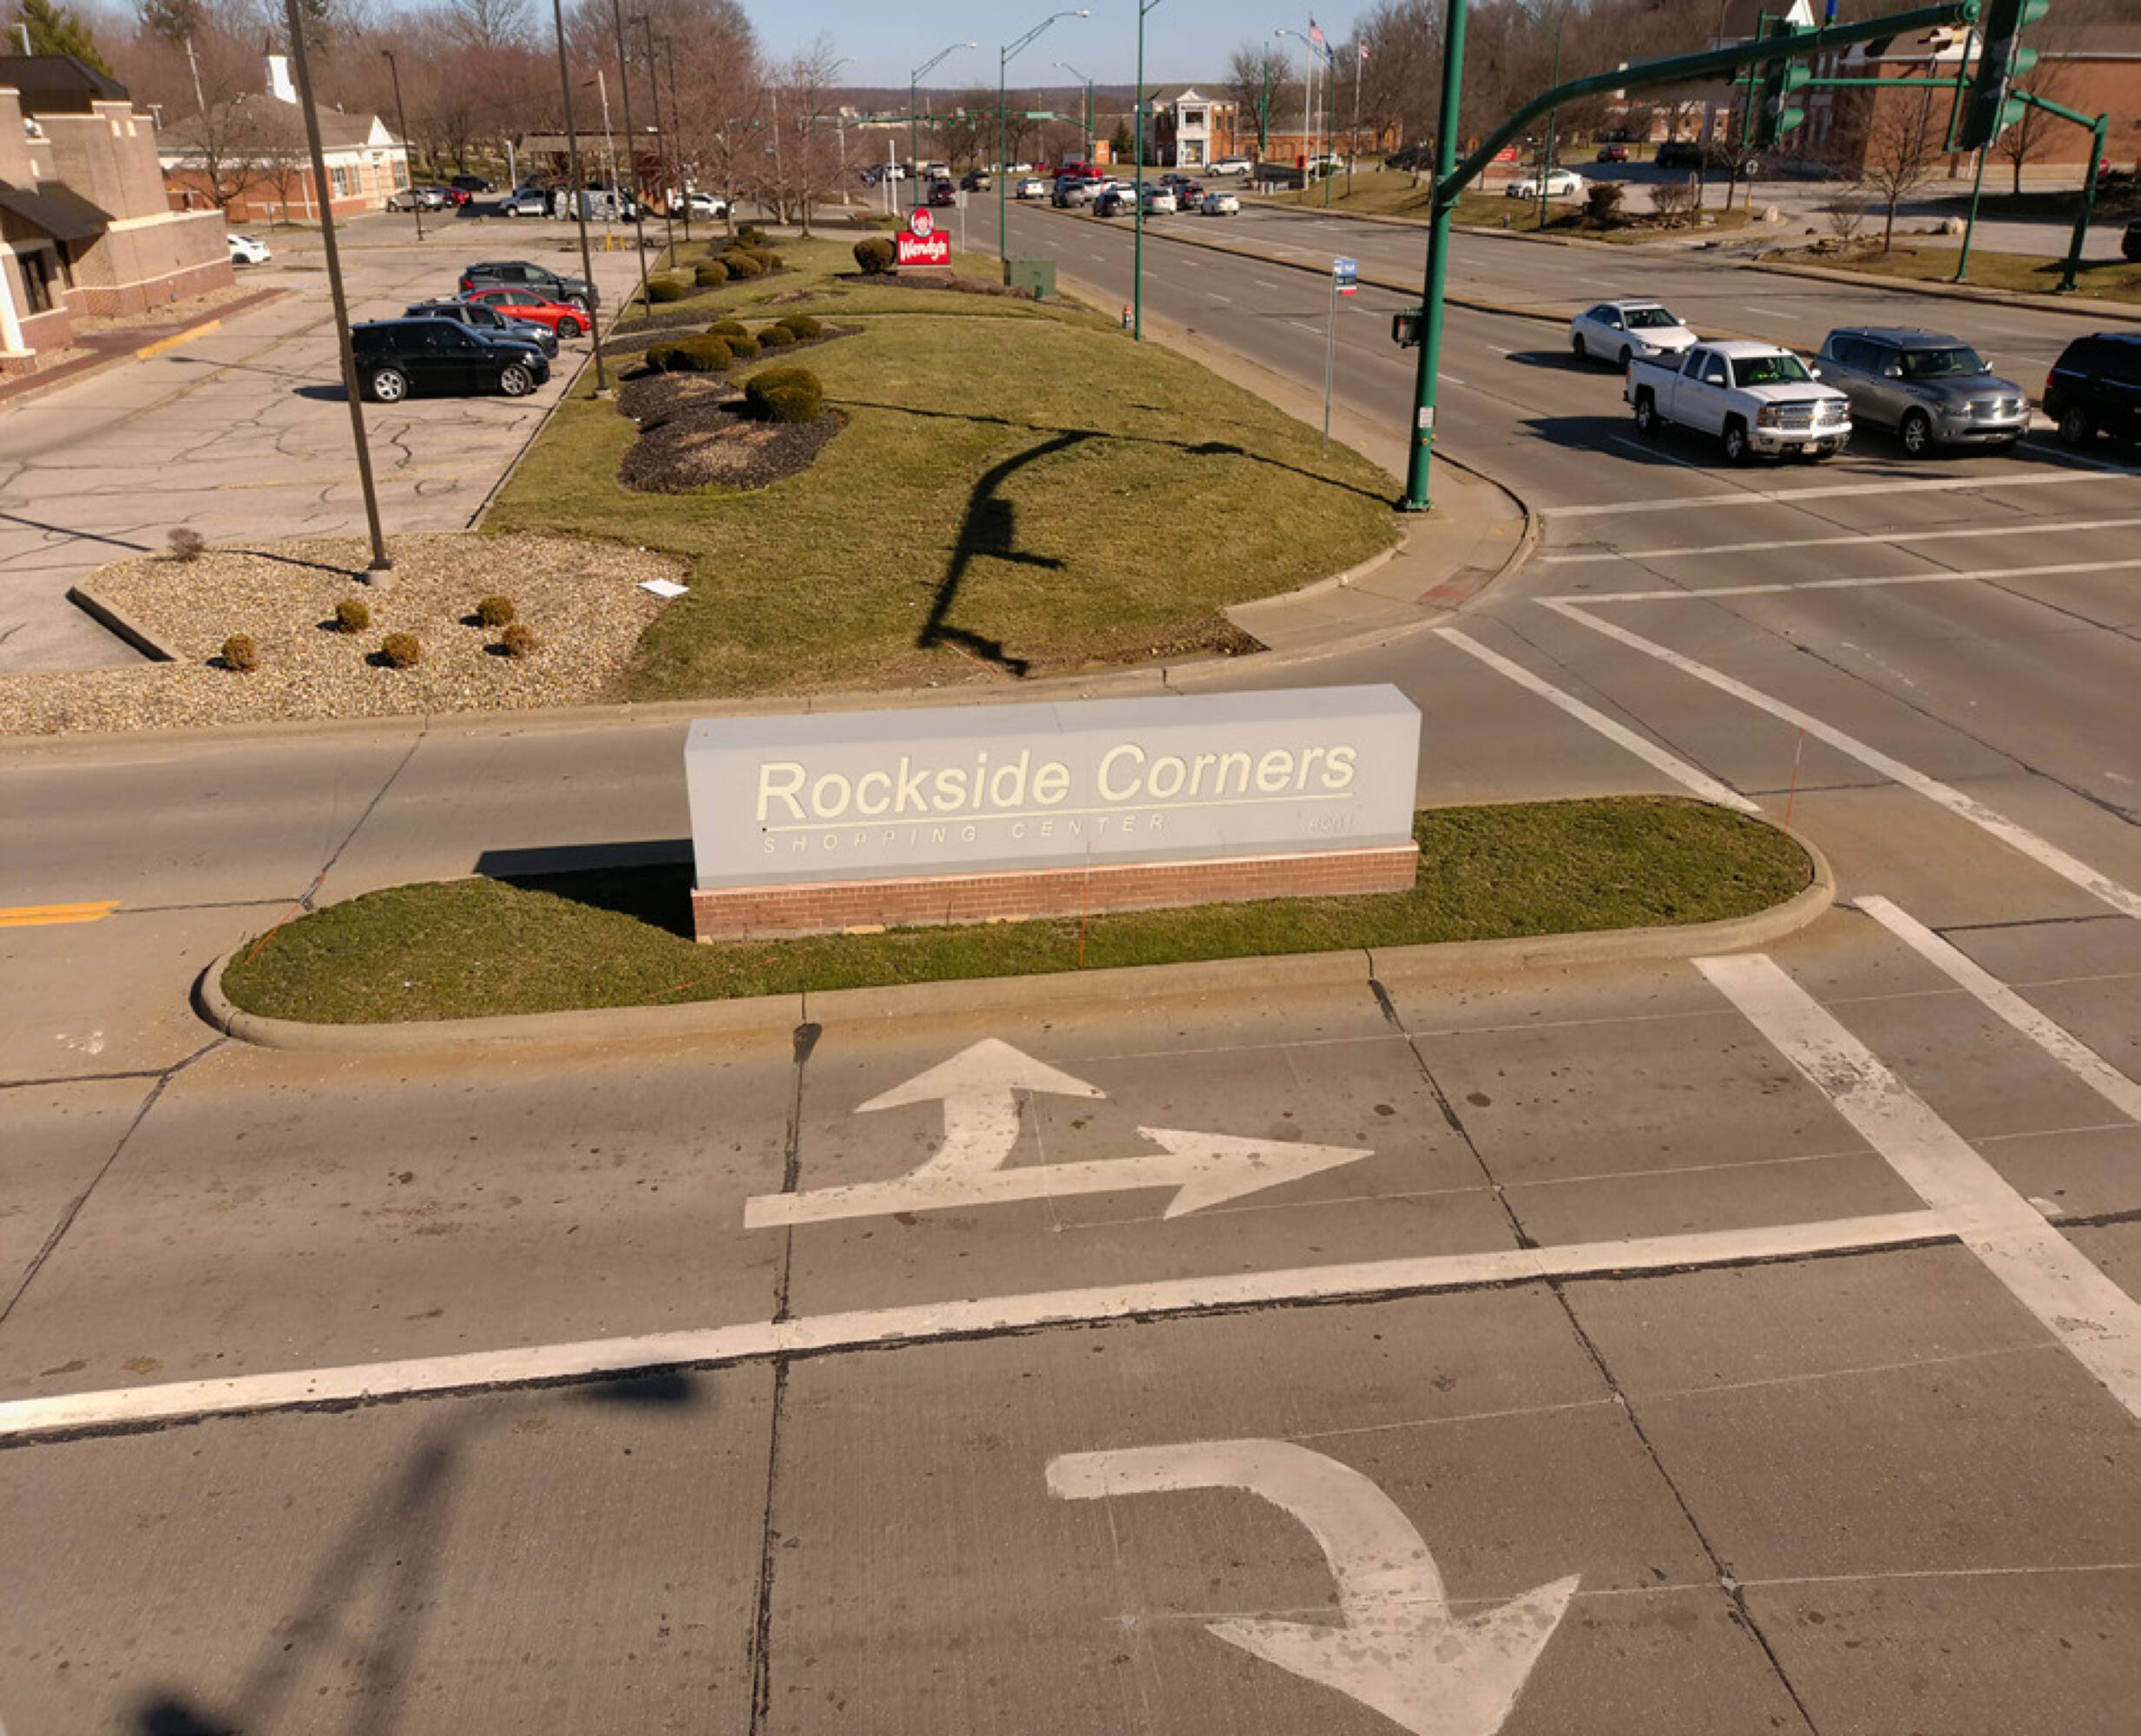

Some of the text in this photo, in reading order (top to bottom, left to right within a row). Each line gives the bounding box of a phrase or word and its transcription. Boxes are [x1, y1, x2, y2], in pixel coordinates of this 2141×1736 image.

[900, 236, 947, 261] Wendy's
[756, 743, 1357, 821] Rockside Corners
[763, 813, 1165, 854] SHOPPING CENTER
